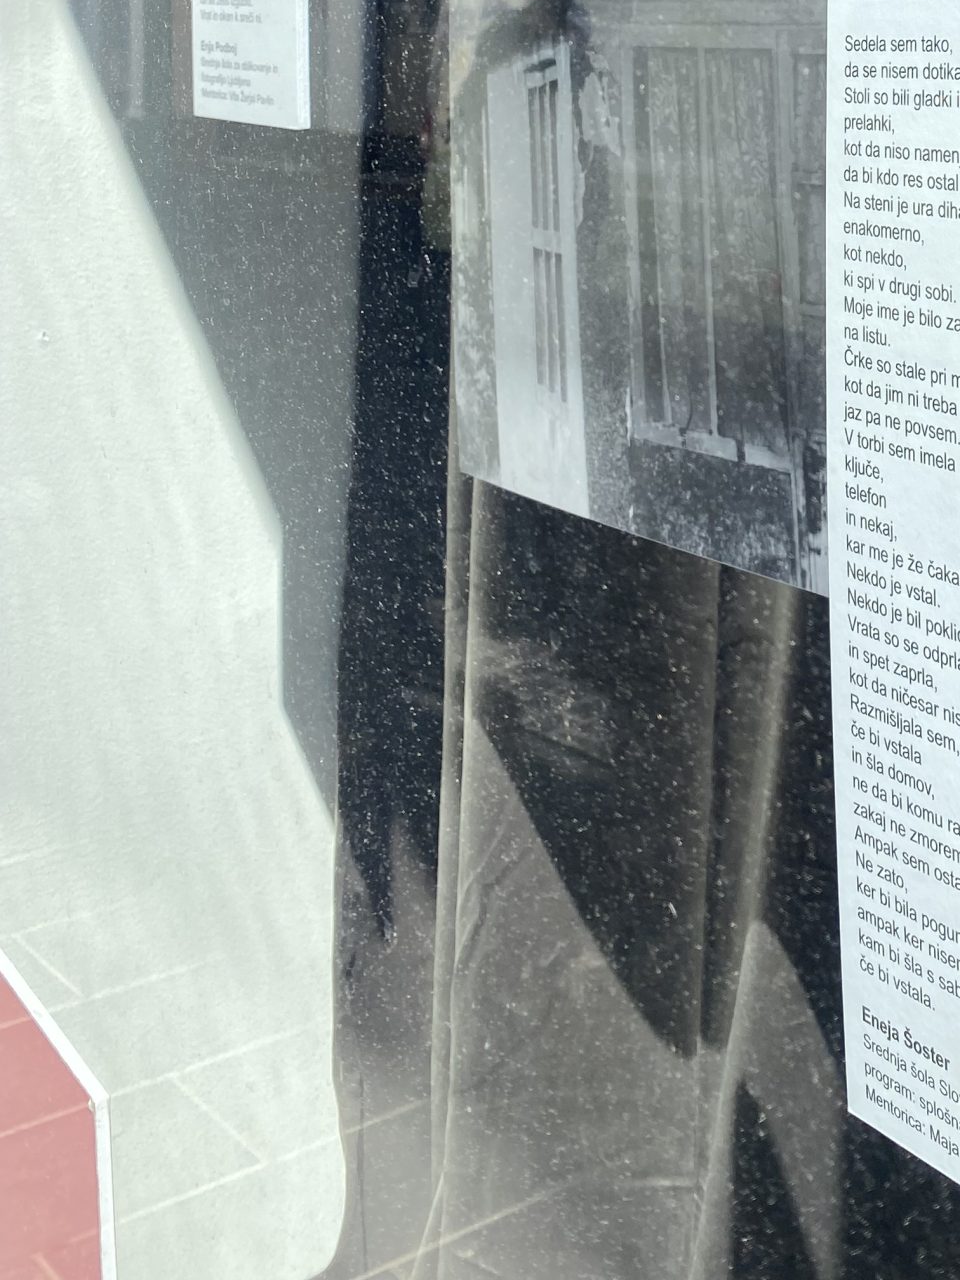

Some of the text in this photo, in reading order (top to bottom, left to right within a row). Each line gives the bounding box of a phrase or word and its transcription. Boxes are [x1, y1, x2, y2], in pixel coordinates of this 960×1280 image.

[844, 34, 953, 56] Sedela sem tako,
[843, 59, 860, 79] da
[861, 64, 878, 79] se
[880, 60, 919, 80] nisem
[843, 86, 871, 105] Stoli
[873, 91, 889, 106] so
[891, 87, 910, 106] bili
[912, 88, 952, 111] gladki
[843, 112, 895, 136] prelahki,
[843, 137, 862, 157] kot
[864, 139, 881, 159] da
[883, 140, 911, 161] niso
[842, 218, 925, 247] enakomerno,
[843, 242, 907, 272] kot nekdo,
[843, 295, 874, 321] Moje
[876, 299, 900, 322] ime
[901, 304, 915, 328] je
[918, 306, 943, 329] bilo
[843, 324, 891, 348] na listu.
[843, 426, 956, 473] V torbi sem imela
[844, 453, 884, 484] ključe,
[844, 480, 887, 509] telefon
[845, 506, 898, 543] in nekaj,
[846, 586, 888, 617] Nekdo
[889, 601, 903, 625] je
[905, 606, 922, 630] bil
[848, 639, 938, 694] in spet zaprla,
[848, 665, 869, 691] kot
[870, 675, 888, 698] da
[890, 684, 940, 718] ničesar
[849, 692, 923, 739] Razmišljala
[926, 728, 960, 757] sem,
[851, 744, 935, 801] in šla domov,
[852, 800, 886, 833] zakaj
[889, 818, 907, 838] ne
[853, 824, 899, 862] Ampak
[901, 850, 931, 877] sem
[855, 848, 908, 895] Ne zato,
[856, 905, 902, 941] ampak
[902, 924, 925, 952] ker
[861, 1004, 951, 1072] Eneja Šoster
[862, 1032, 908, 1074] Srednja
[910, 1060, 936, 1091] šola
[863, 1061, 918, 1104] program:
[865, 1082, 926, 1136] Mentorica:
[928, 1123, 960, 1158] Maja
